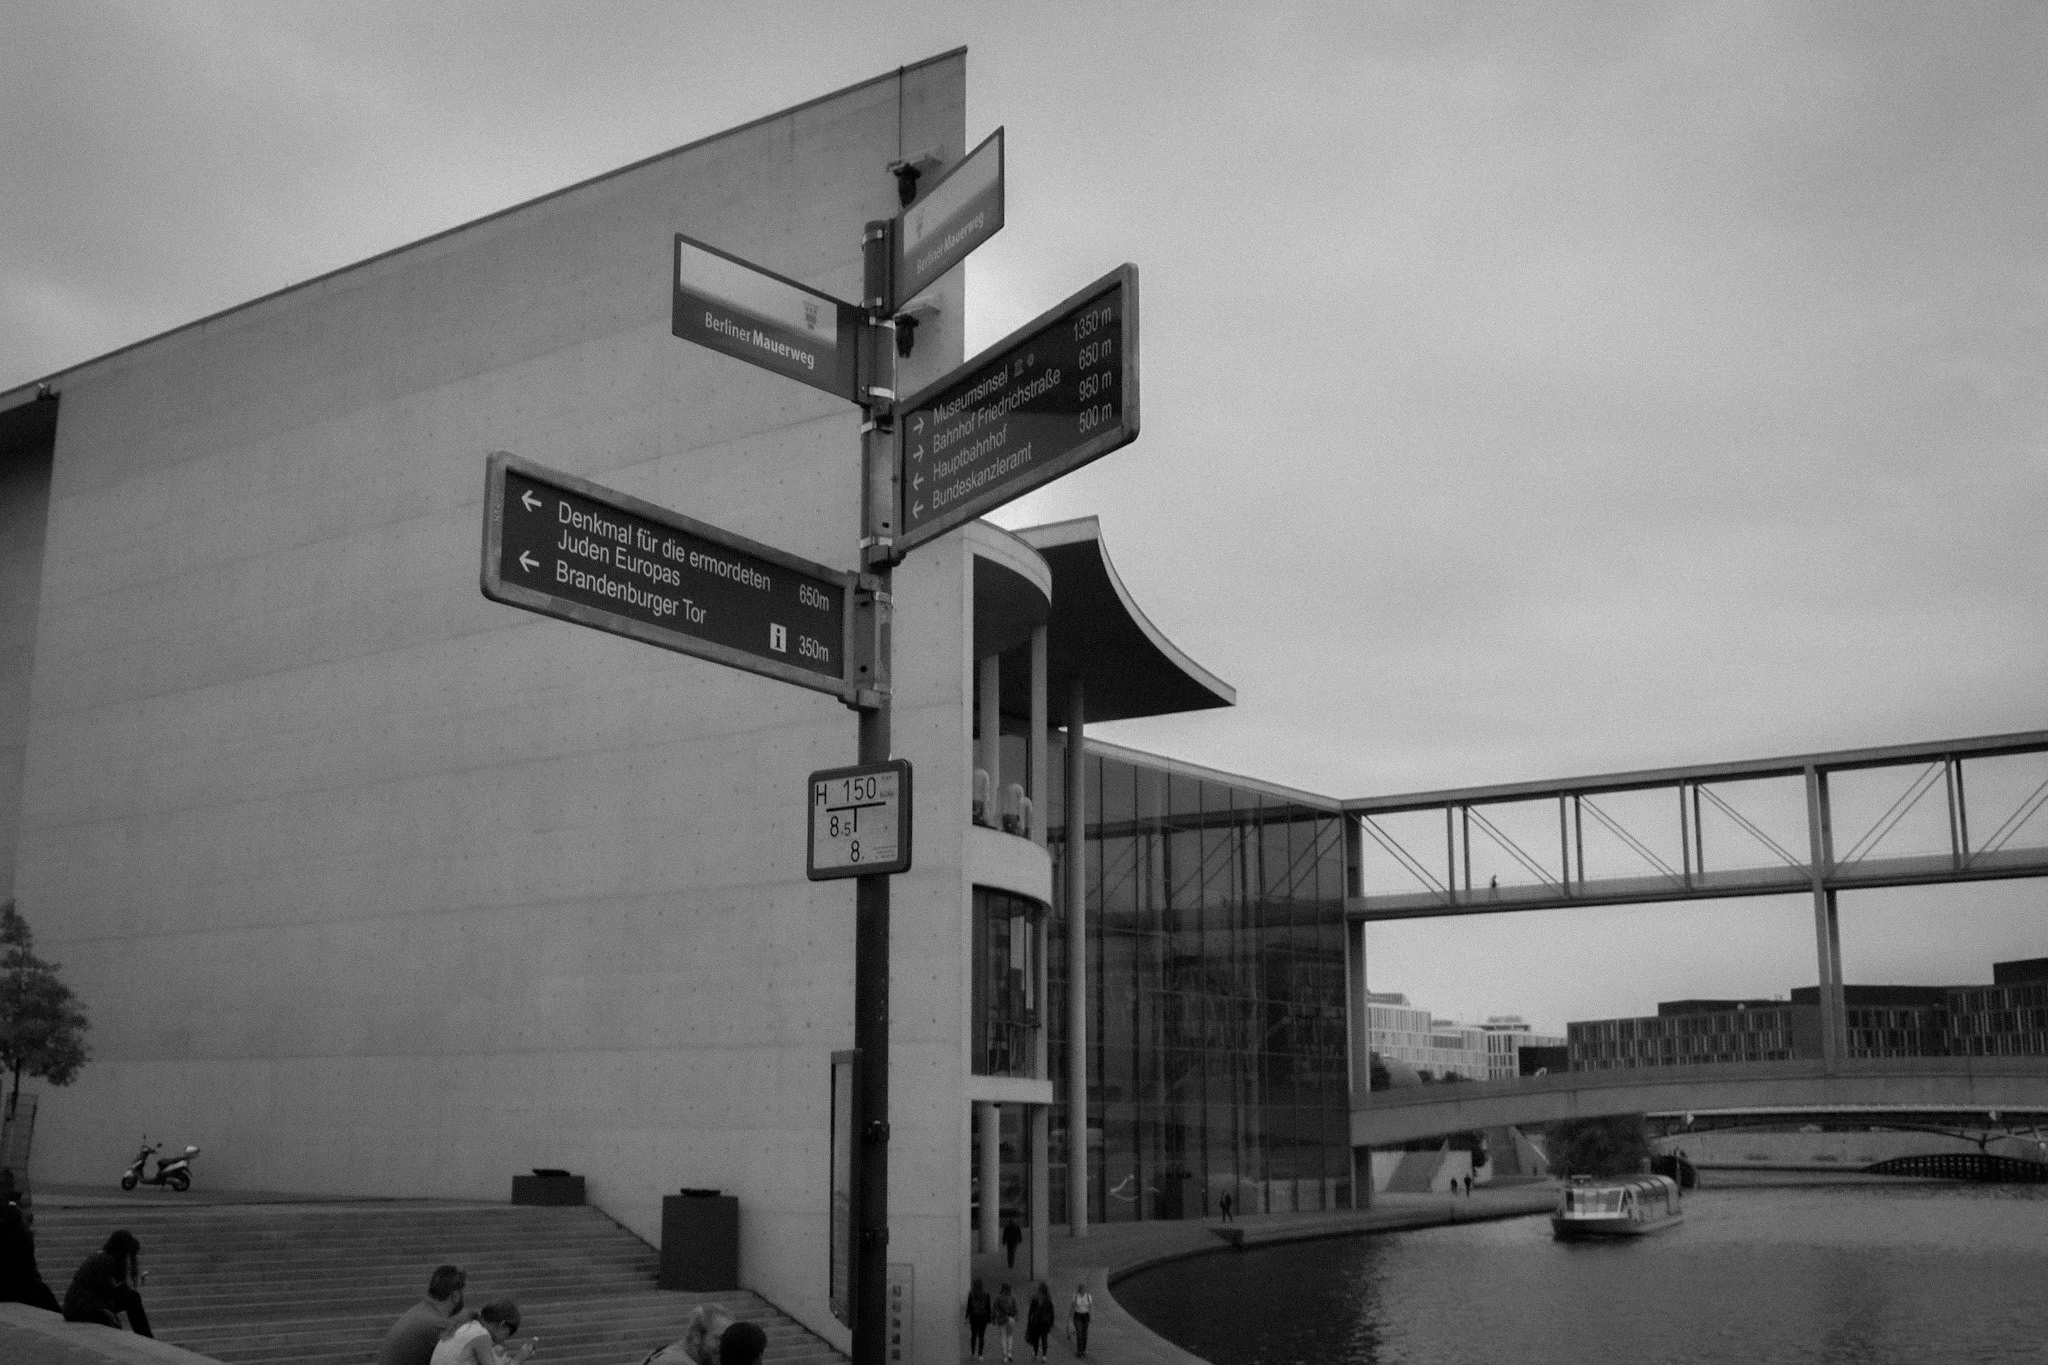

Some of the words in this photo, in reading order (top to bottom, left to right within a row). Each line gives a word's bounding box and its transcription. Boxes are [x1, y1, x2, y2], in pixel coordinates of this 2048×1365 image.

[705, 311, 750, 342] Berliner
[753, 329, 814, 369] Mauerweg
[933, 364, 1008, 426] Museumsinsel
[1074, 310, 1099, 342] 1350
[1101, 307, 1112, 326] m
[933, 412, 976, 454] Bahnhof
[977, 368, 1061, 427] Friedrichstraße
[1078, 341, 1099, 370] 650
[1101, 339, 1112, 358] m
[933, 423, 1008, 482] Hauptbahnhof
[1079, 373, 1099, 402] 950
[1101, 371, 1112, 390] m
[932, 441, 1032, 510] Bundeskanzleramt
[1079, 405, 1099, 433] 500
[1101, 402, 1112, 422] m
[558, 500, 632, 545] Denkmal
[636, 528, 659, 553] für
[662, 538, 685, 563] die
[690, 551, 771, 591] ermordeten
[799, 584, 830, 612] 650m
[558, 529, 610, 564] Juden
[615, 547, 681, 586] Europas
[556, 559, 679, 617] Brandenburger
[683, 598, 706, 624] Tor
[798, 635, 829, 662] 350m
[816, 783, 827, 806] H
[843, 776, 877, 803] 150
[850, 840, 860, 862] 8
